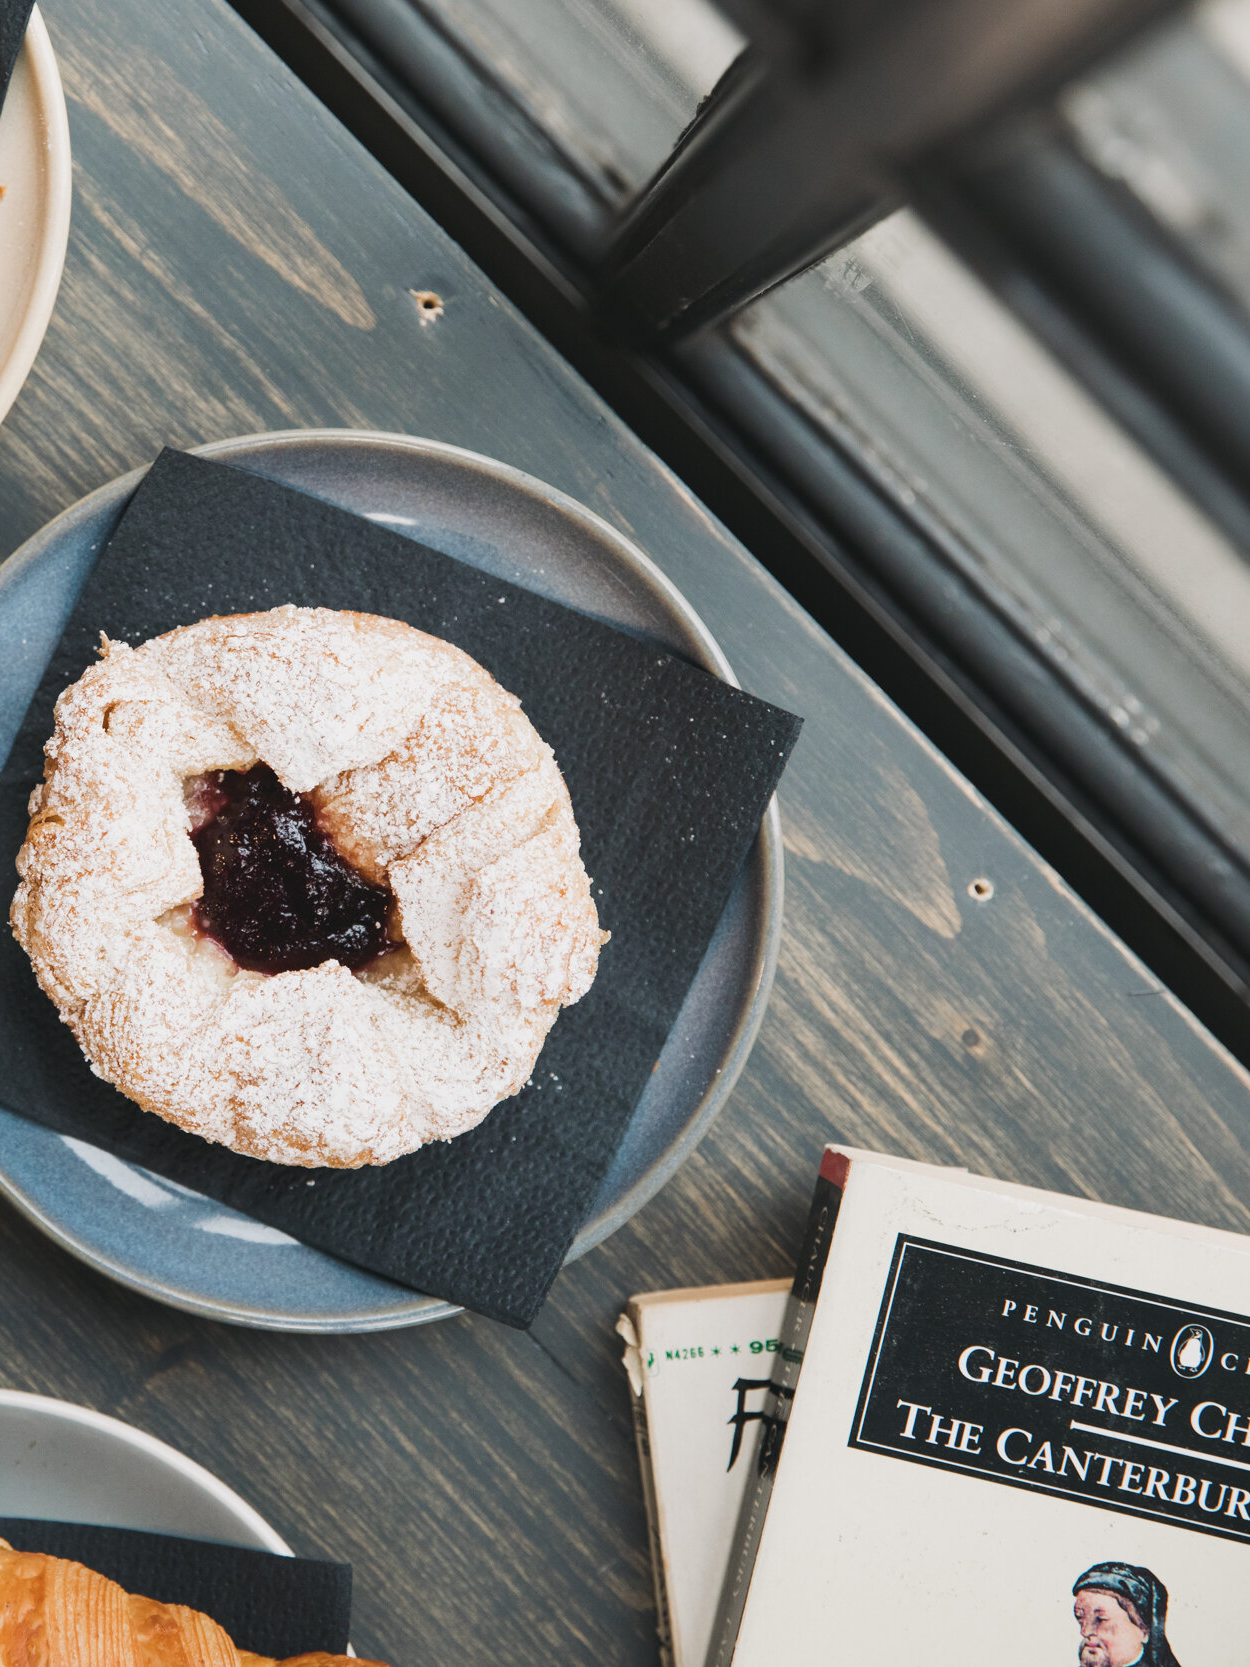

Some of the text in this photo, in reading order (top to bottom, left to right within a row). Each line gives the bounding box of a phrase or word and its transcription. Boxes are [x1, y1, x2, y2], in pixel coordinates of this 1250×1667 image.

[1002, 1299, 1250, 1375] PENGUIN C
[958, 1345, 1179, 1427] GEOFFREY
[897, 1399, 1250, 1522] THE CANTERBUR
